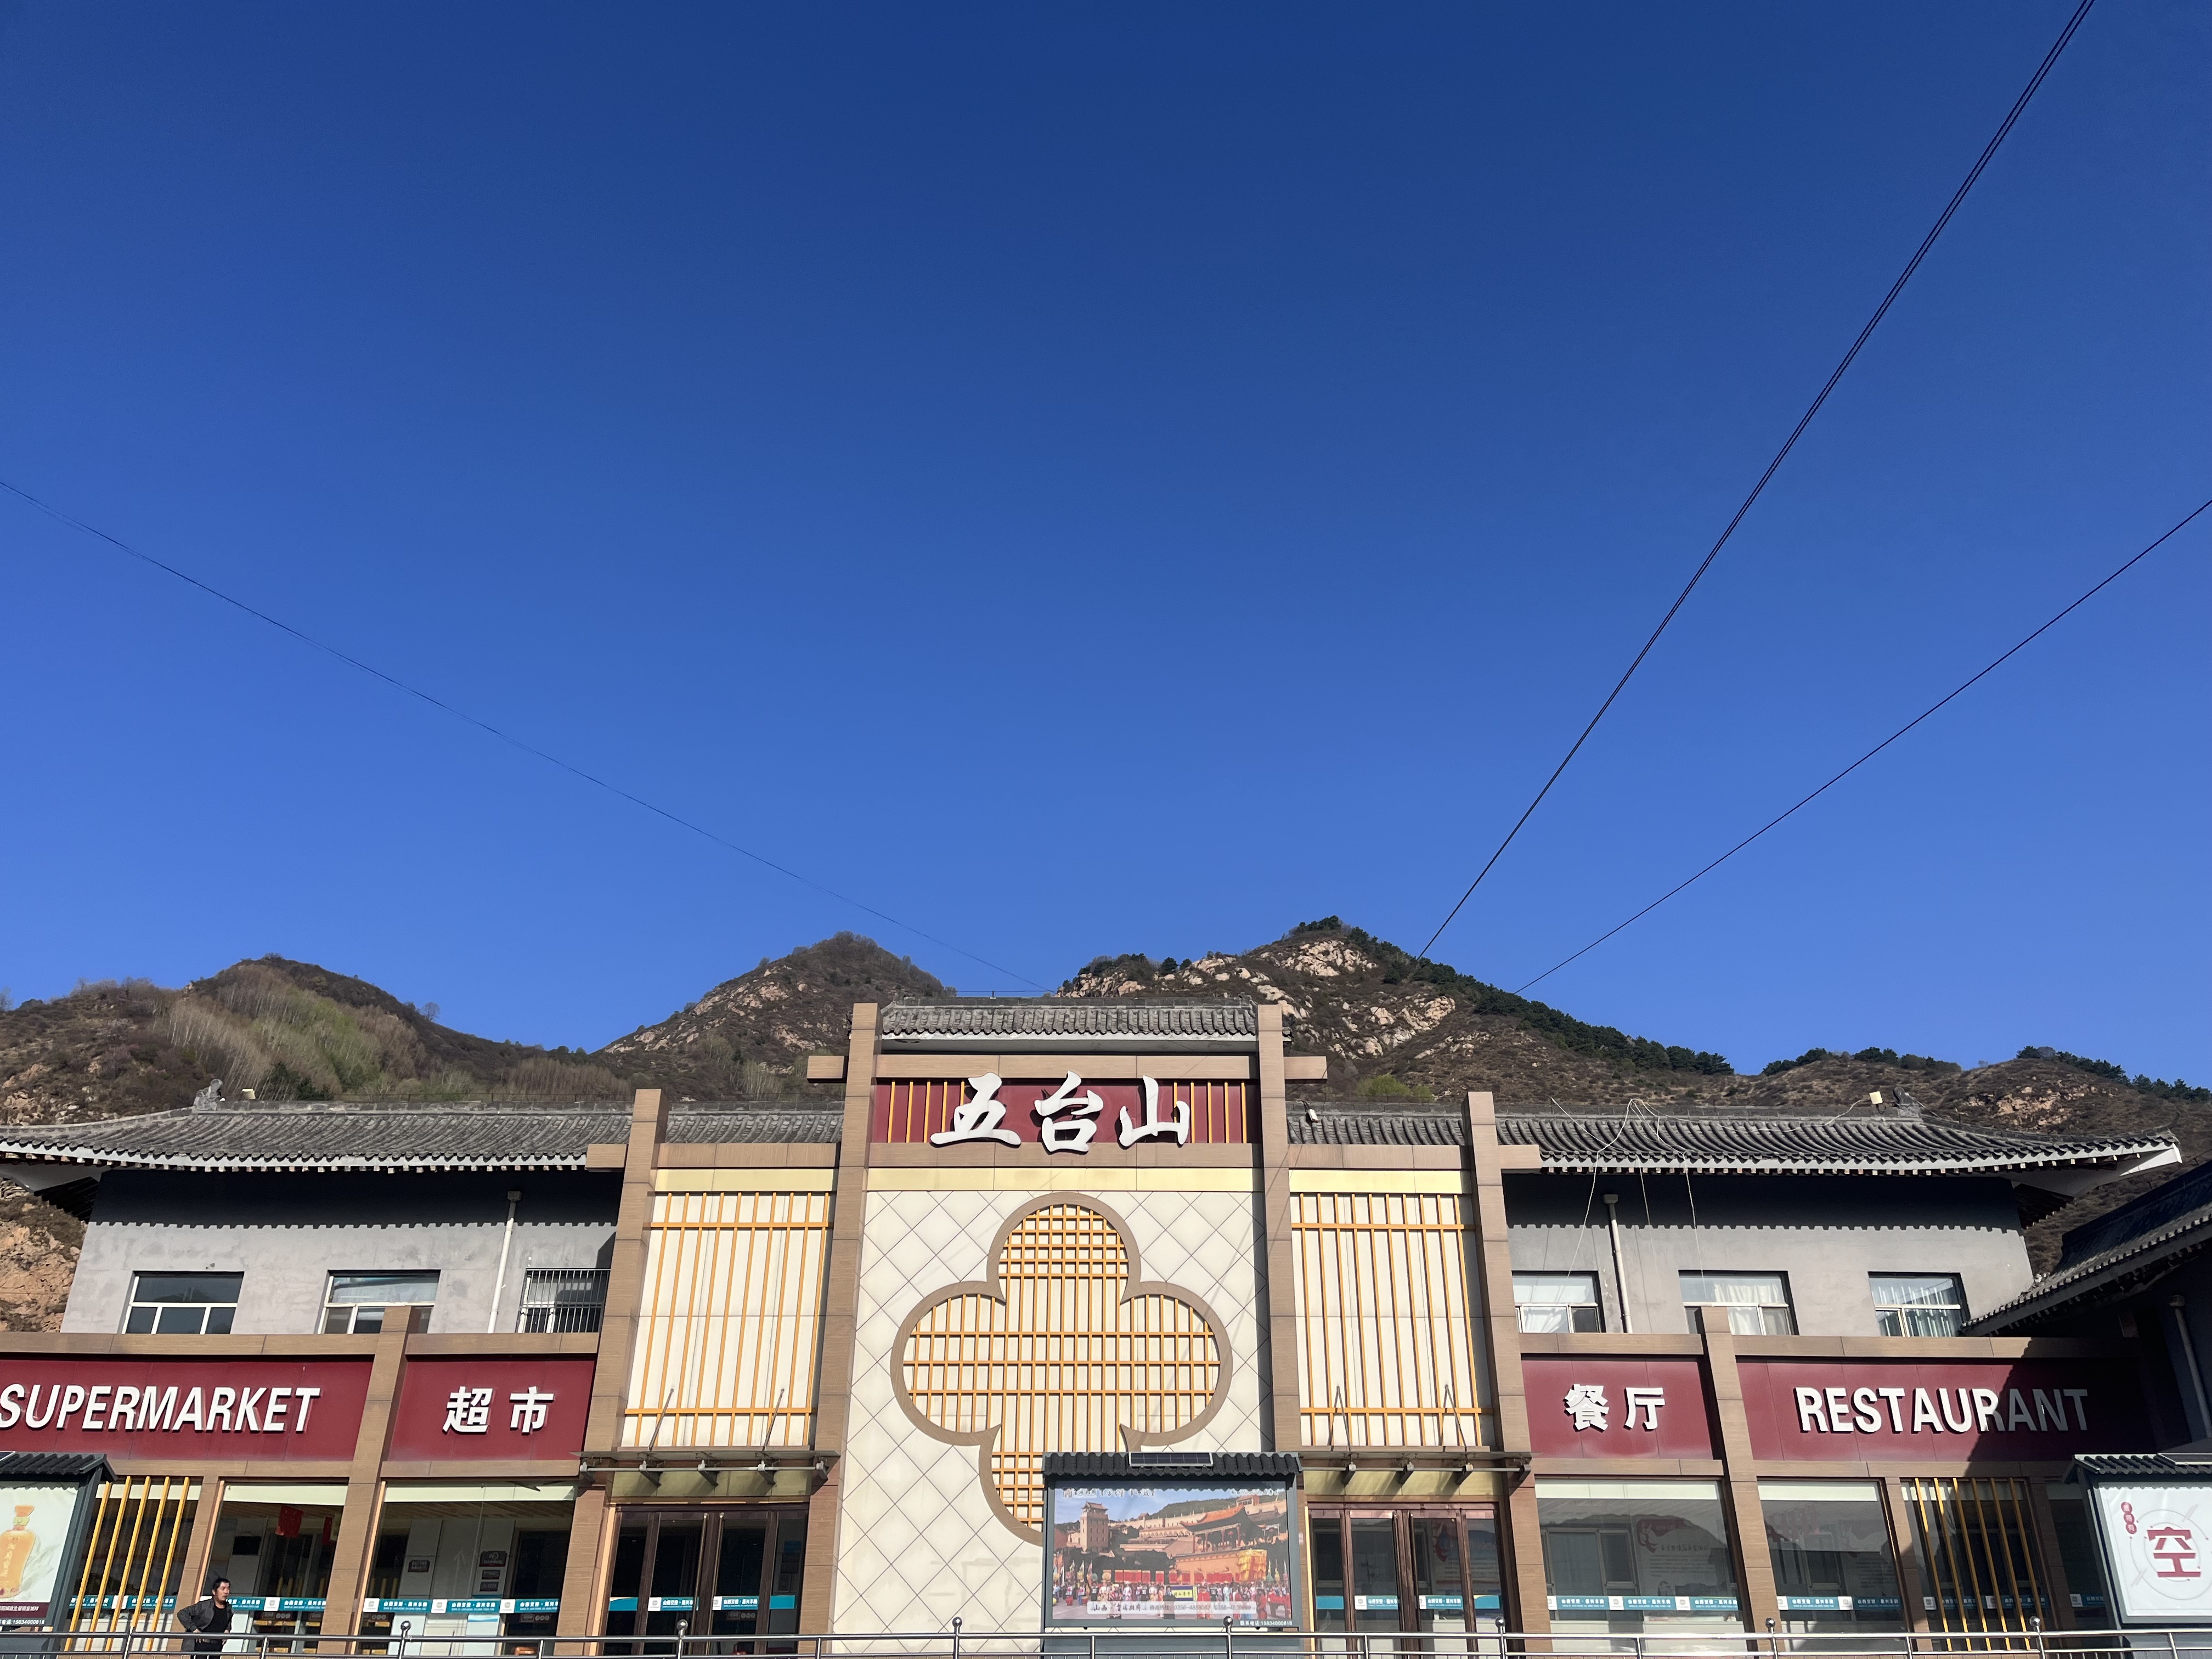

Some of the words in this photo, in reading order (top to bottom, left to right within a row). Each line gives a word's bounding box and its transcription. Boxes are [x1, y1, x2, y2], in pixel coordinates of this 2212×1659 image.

[930, 1070, 1190, 1153] 五台山
[0, 1384, 321, 1432] SUPERMARKET
[443, 1386, 554, 1434] 超市
[1564, 1384, 1666, 1431] 餐厅
[1795, 1387, 2088, 1432] RESTAURANT
[2147, 1527, 2202, 1577] 空
